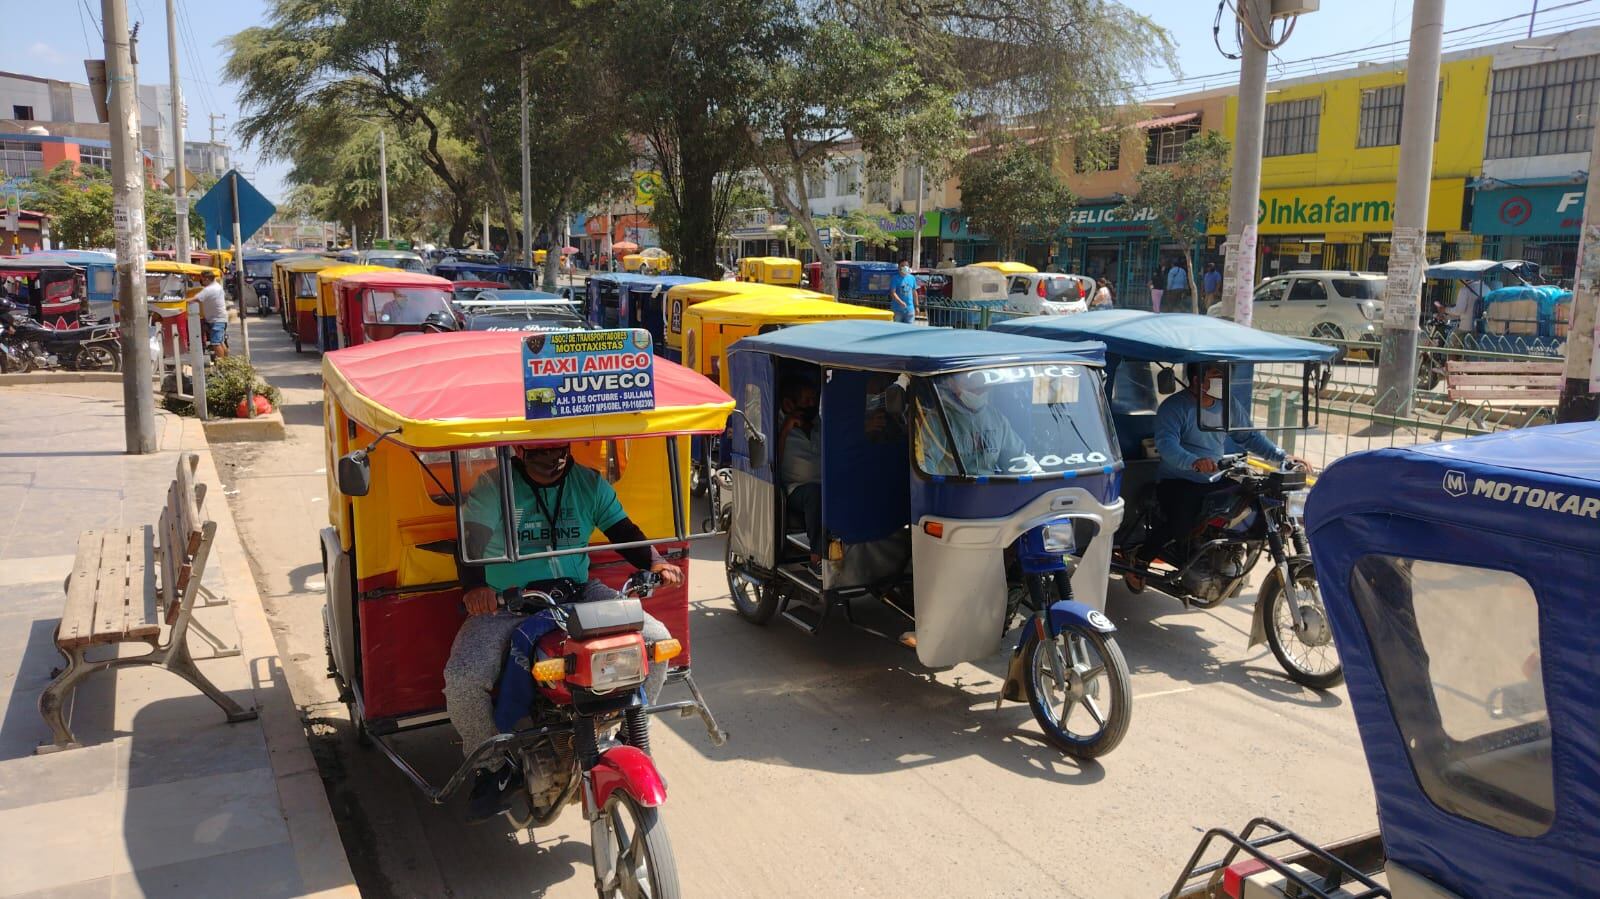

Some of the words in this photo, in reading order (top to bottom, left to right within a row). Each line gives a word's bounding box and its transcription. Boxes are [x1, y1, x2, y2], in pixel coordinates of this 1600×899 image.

[1269, 195, 1396, 225] Inkafarm
[556, 341, 624, 353] MOTOTAXISTAS
[529, 357, 578, 376] TAXI
[582, 352, 651, 373] AMIGO
[558, 373, 649, 393] JUVECO
[577, 395, 587, 403] DE
[587, 392, 619, 402] OCTUBRE
[623, 390, 653, 400] SULLANA
[1471, 478, 1600, 519] MOTOKAR
